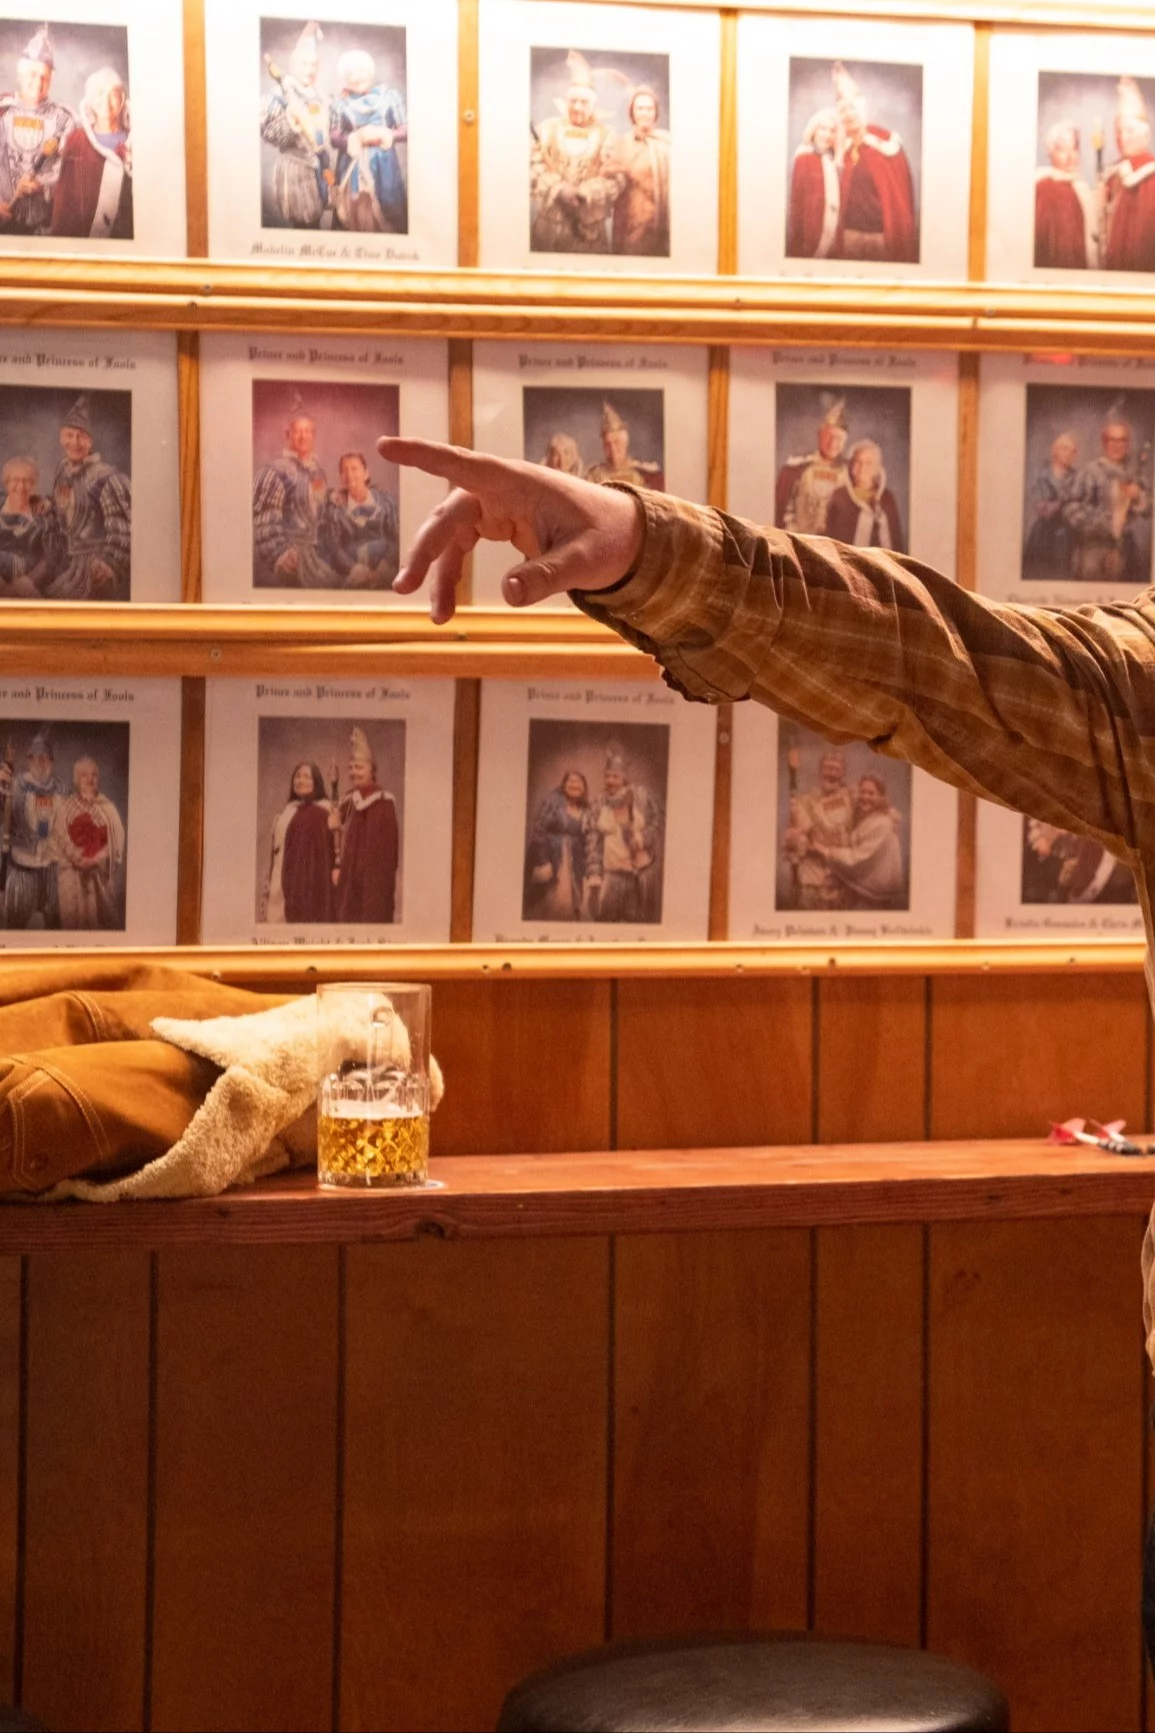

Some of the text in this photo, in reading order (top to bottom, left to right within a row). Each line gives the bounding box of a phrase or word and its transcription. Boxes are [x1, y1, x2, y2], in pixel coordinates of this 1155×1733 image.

[11, 355, 32, 365] and
[36, 354, 86, 368] Princess
[88, 357, 99, 368] of
[248, 346, 283, 361] Prince
[286, 351, 306, 360] and
[308, 349, 355, 363] Princess
[358, 353, 369, 363] of
[11, 689, 31, 699] and
[35, 687, 84, 702] Princess
[87, 690, 98, 701] of
[256, 684, 290, 699] Prince
[293, 688, 312, 698] and
[316, 685, 362, 700] Princess
[365, 687, 375, 699] of
